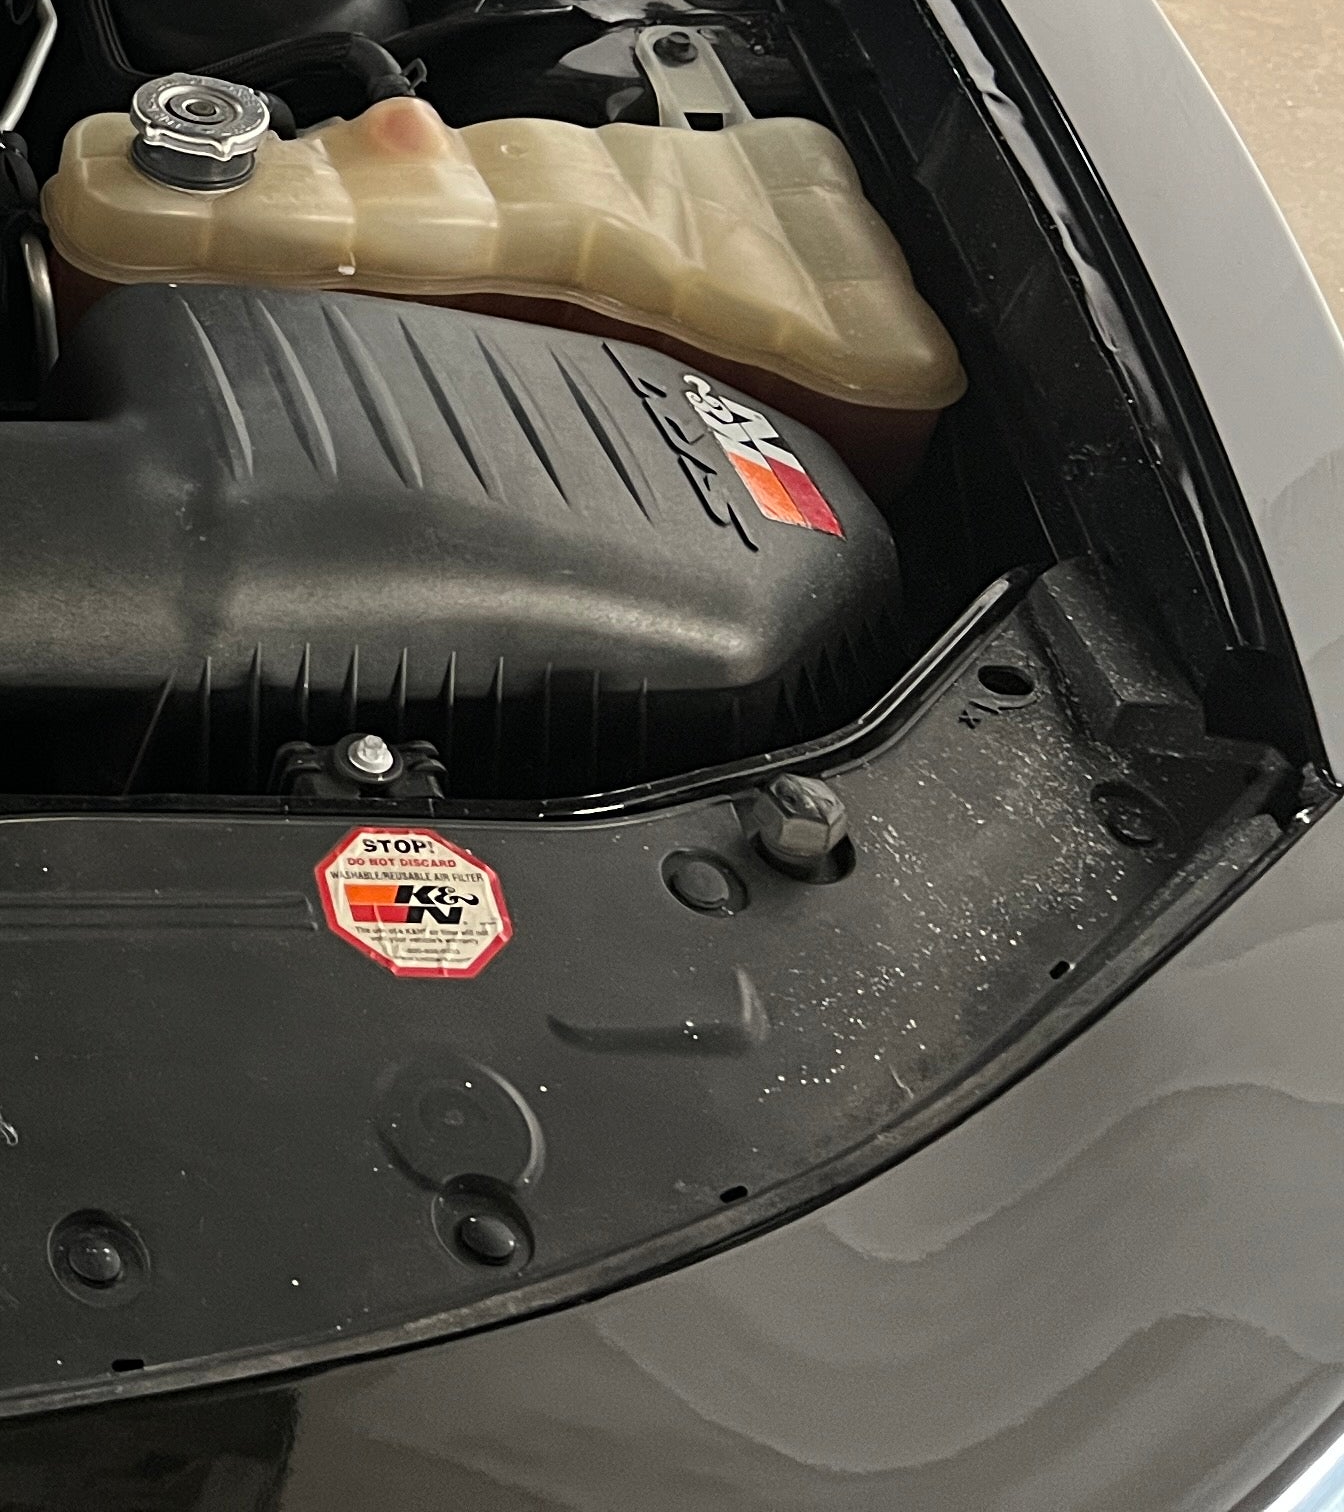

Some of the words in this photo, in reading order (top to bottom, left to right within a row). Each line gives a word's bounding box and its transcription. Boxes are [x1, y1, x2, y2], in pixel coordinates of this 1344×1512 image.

[363, 839, 434, 854] STOP!
[347, 857, 364, 866] DO
[370, 858, 396, 867] NOT
[400, 858, 457, 867] DISCARD
[434, 873, 450, 881] AIR
[452, 872, 484, 882] FILTER
[395, 885, 479, 925] K&N
